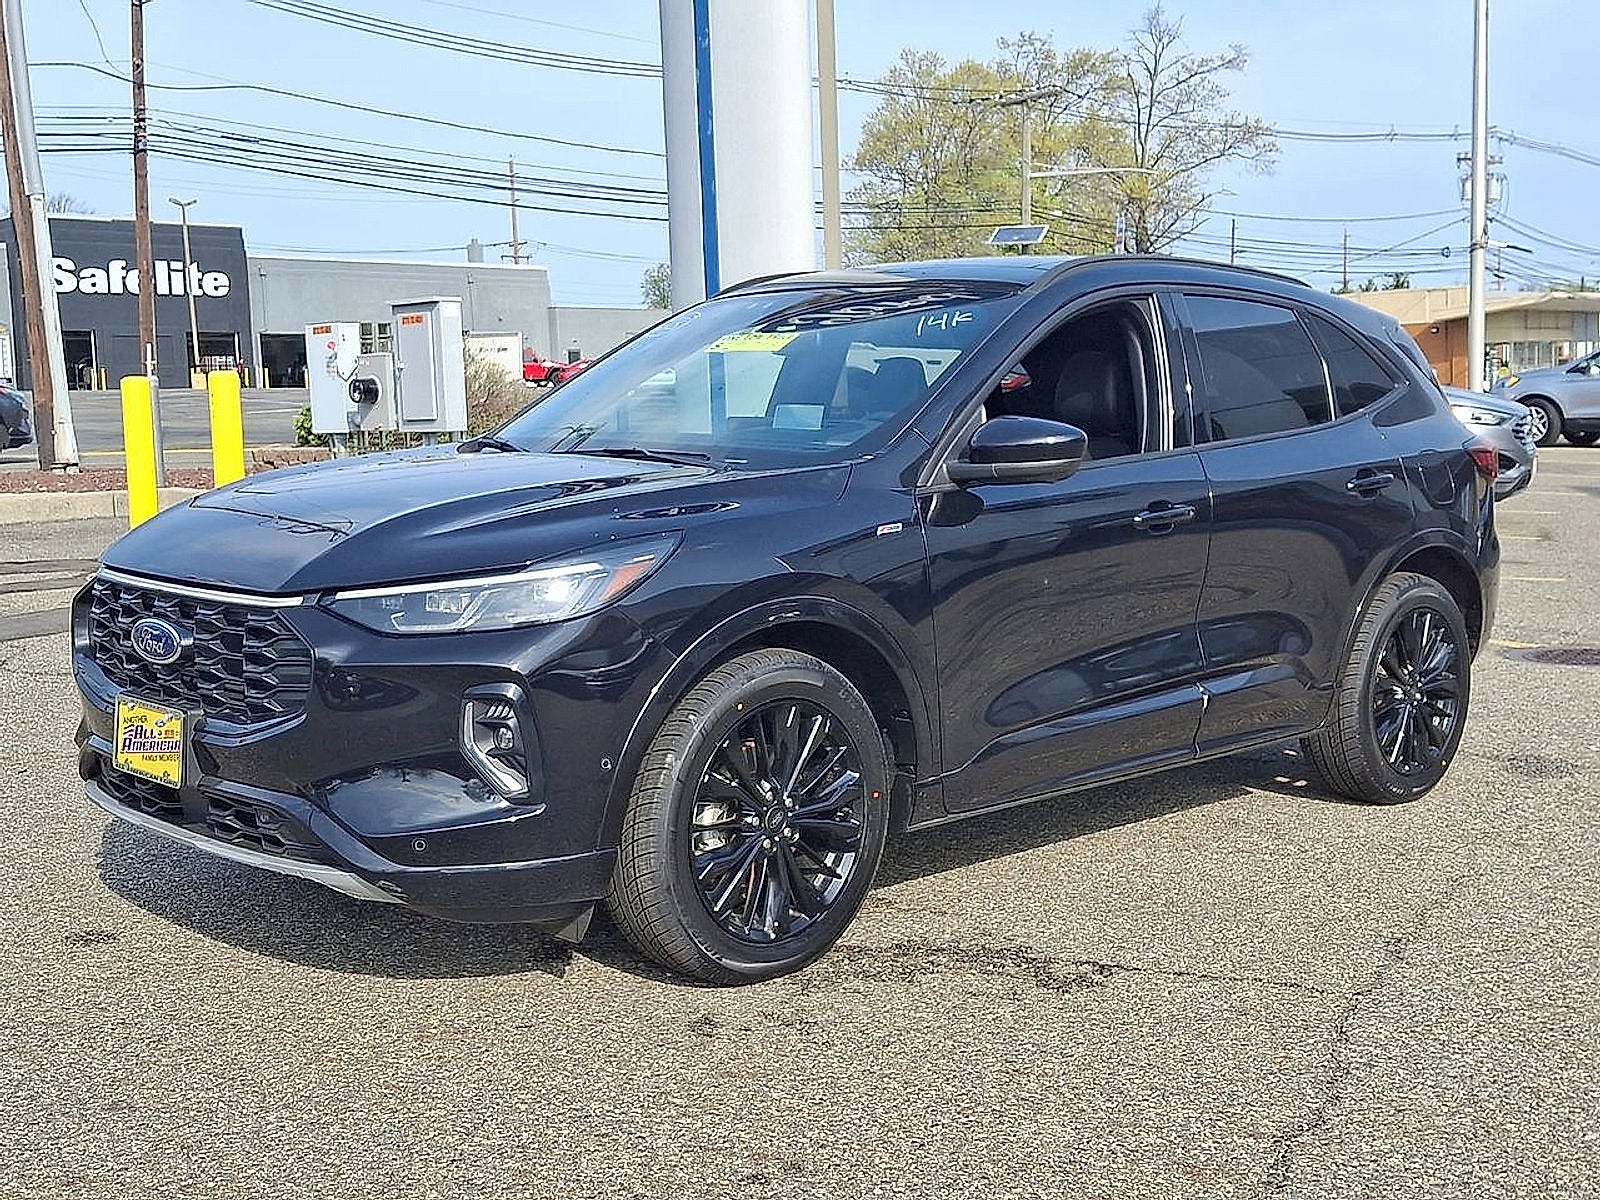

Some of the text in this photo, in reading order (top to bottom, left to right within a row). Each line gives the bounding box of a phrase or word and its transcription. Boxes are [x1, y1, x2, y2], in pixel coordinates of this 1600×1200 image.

[917, 310, 973, 336] 14K
[138, 626, 166, 655] Ford
[133, 725, 156, 739] ALL
[121, 738, 180, 751] AMERICAN
